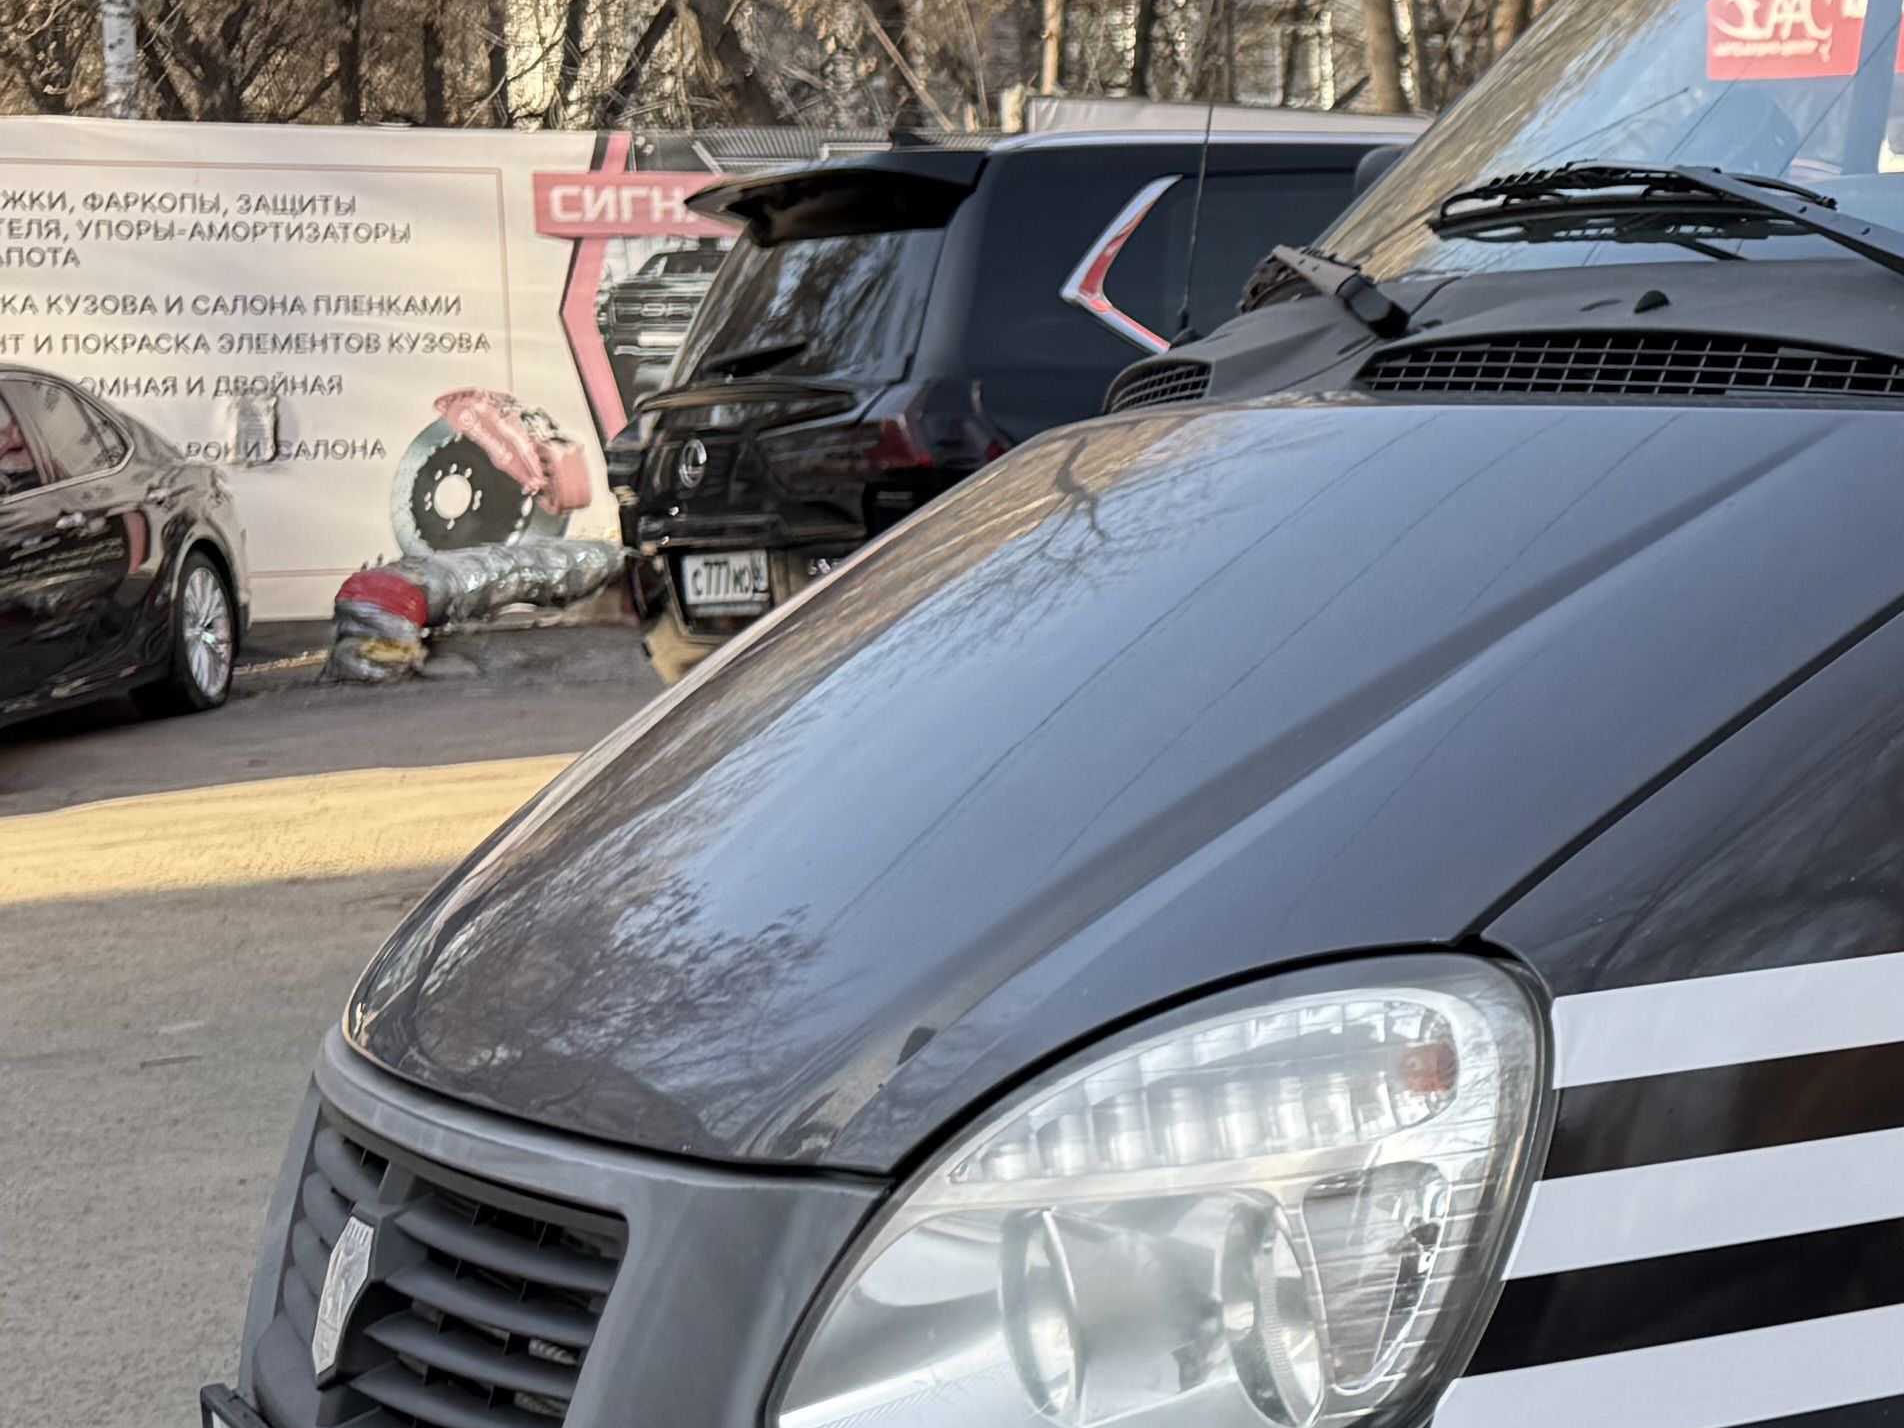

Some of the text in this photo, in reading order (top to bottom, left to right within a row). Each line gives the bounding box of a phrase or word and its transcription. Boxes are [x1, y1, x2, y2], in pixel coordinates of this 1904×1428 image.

[82, 191, 229, 218] ФАРКОПЫ,
[236, 193, 356, 219] ЗАЩИТЫ
[550, 185, 698, 223] СИГН
[76, 218, 411, 244] УПОРЫ-АМОРТИЗАТОРЫ
[0, 246, 81, 269] ПОТА
[46, 294, 158, 316] КУЗОВА
[164, 294, 184, 316] И
[191, 294, 307, 316] САЛОНА
[313, 294, 462, 317] ПЛЕНКАМИ
[34, 332, 53, 355] И
[62, 332, 211, 355] ПОКРАСКА
[217, 332, 381, 355] ЭЛЕМЕНТОВ
[388, 332, 491, 355] КУЗОВА
[186, 375, 205, 398] И
[212, 371, 343, 400] ДВОЙНАЯ
[278, 437, 386, 462] САЛОНА
